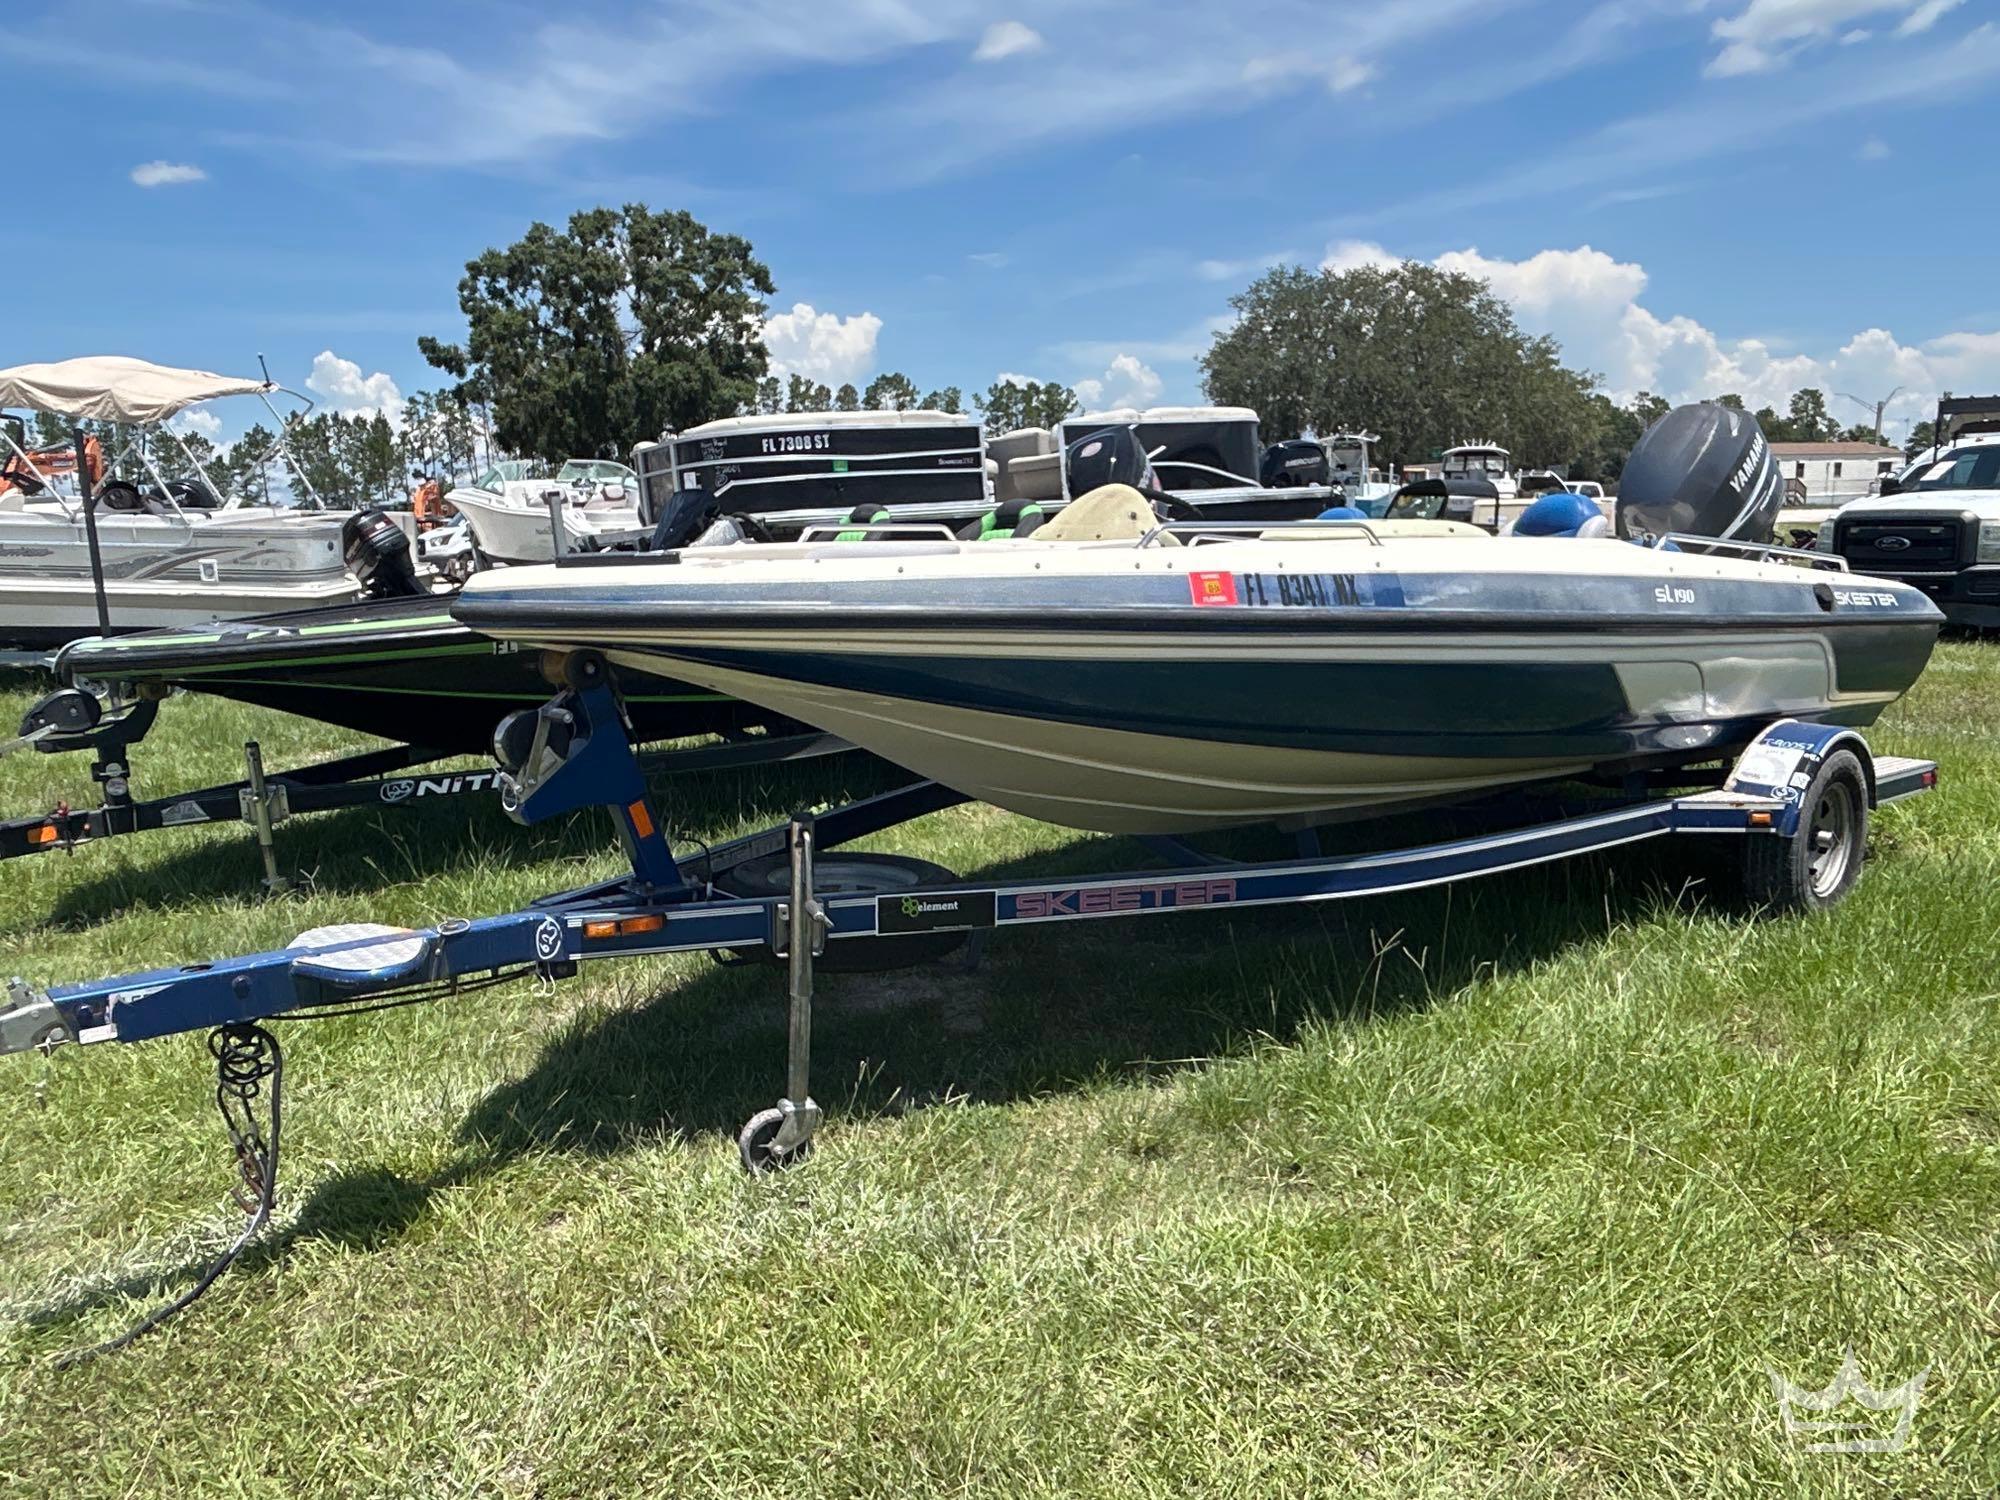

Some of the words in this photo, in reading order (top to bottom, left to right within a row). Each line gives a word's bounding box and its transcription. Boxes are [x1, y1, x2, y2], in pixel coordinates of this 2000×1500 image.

[761, 438, 777, 453] FL
[813, 433, 831, 449] ST
[1729, 431, 1765, 494] YAMAHA
[1243, 573, 1269, 606] FL
[1833, 591, 1900, 607] SKEETER
[917, 900, 959, 912] element
[1015, 878, 1238, 919] SKEETER
